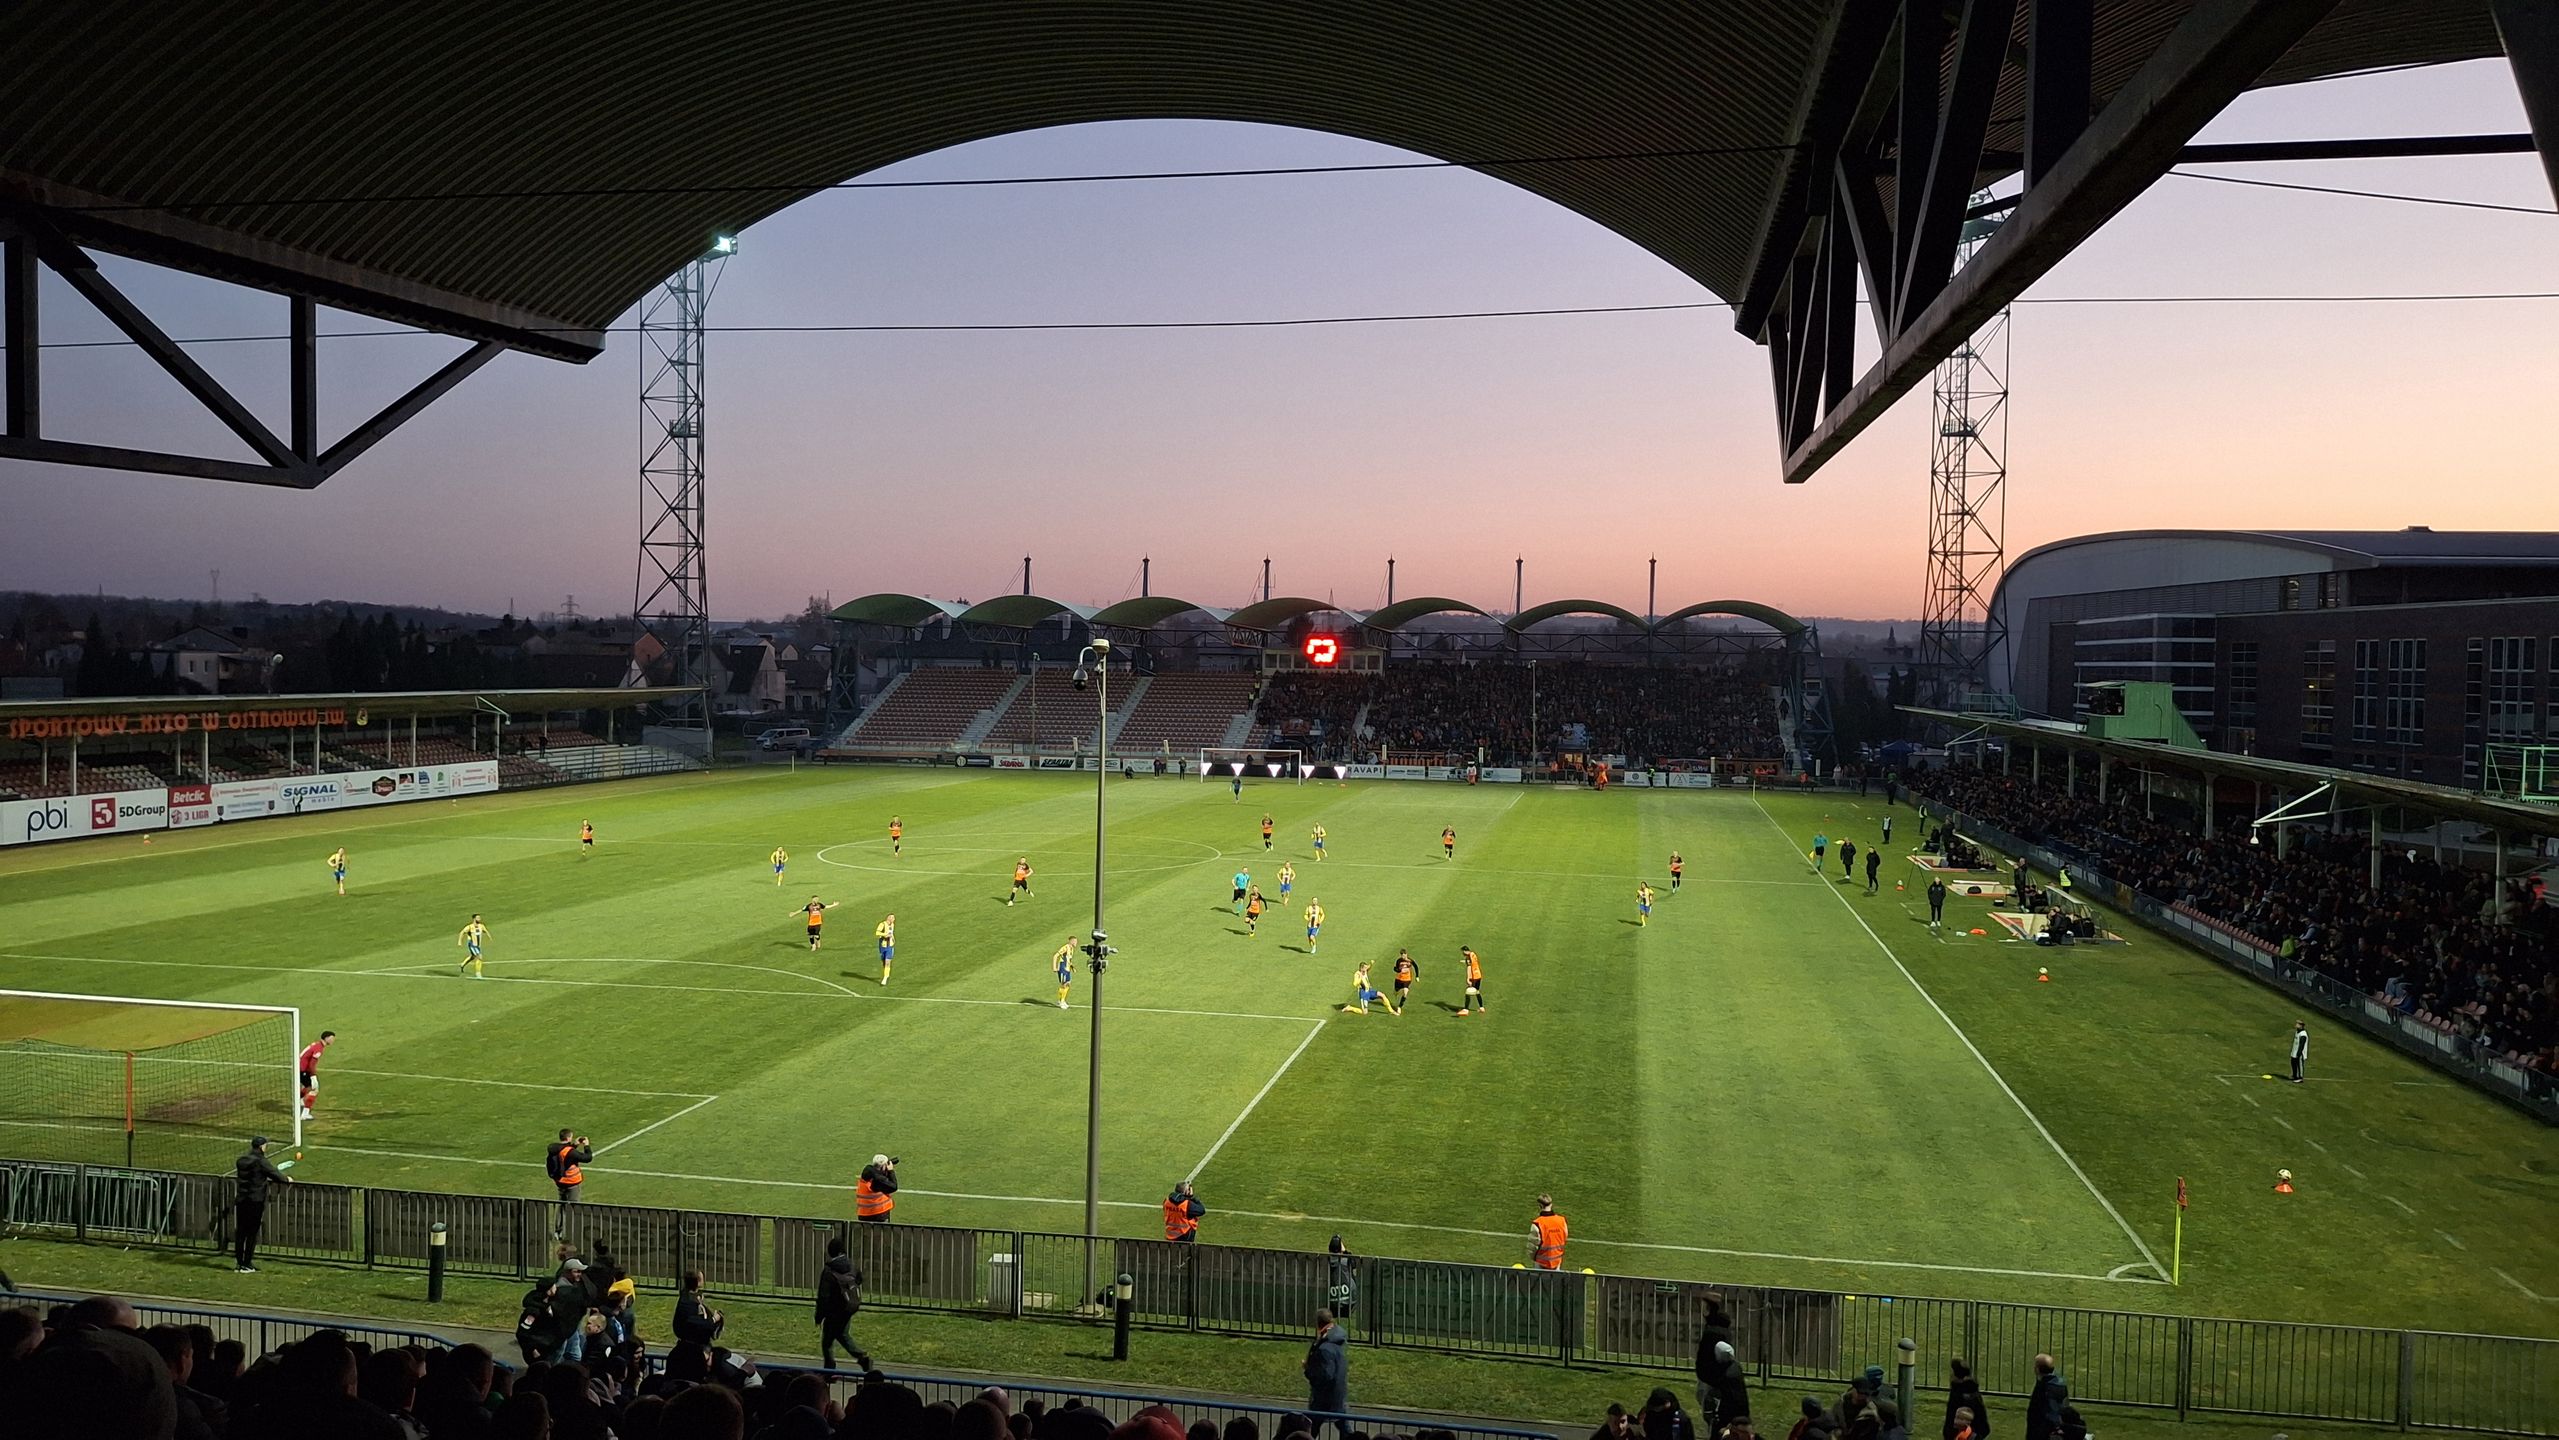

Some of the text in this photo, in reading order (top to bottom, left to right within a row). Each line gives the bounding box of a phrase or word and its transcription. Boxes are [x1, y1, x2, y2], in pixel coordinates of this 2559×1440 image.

[9, 714, 128, 739] SPORTOWY
[201, 712, 220, 731] W
[228, 709, 318, 729] OSTROWCU
[173, 789, 206, 804] Betclic
[283, 784, 337, 798] SIGNAL
[119, 805, 166, 818] 5DGroup
[27, 800, 67, 840] pbi
